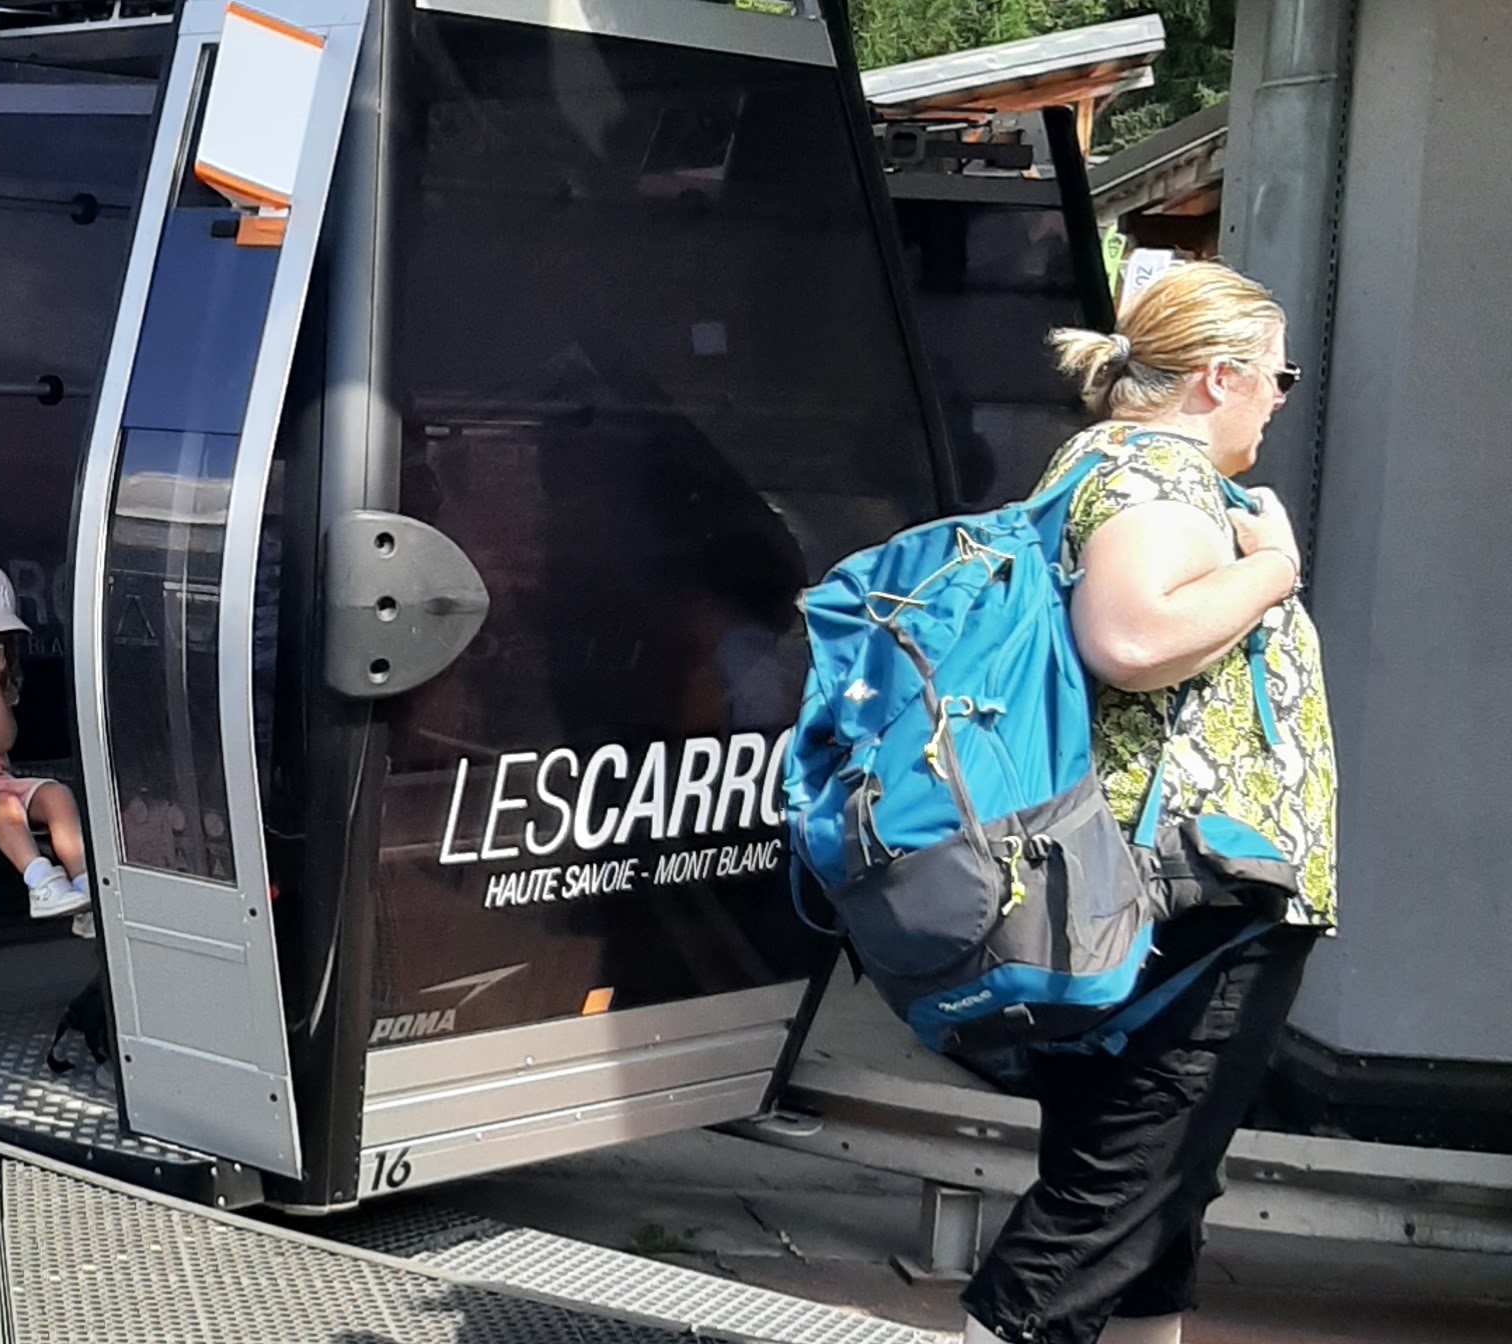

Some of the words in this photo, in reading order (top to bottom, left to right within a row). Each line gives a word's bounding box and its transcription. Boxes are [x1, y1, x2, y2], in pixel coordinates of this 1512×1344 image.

[484, 866, 562, 908] HAUTE
[561, 858, 639, 899] SAVOIE
[653, 847, 717, 886] MONT
[716, 838, 782, 877] BLANC
[368, 1008, 457, 1043] POMA
[371, 1146, 411, 1191] 16
